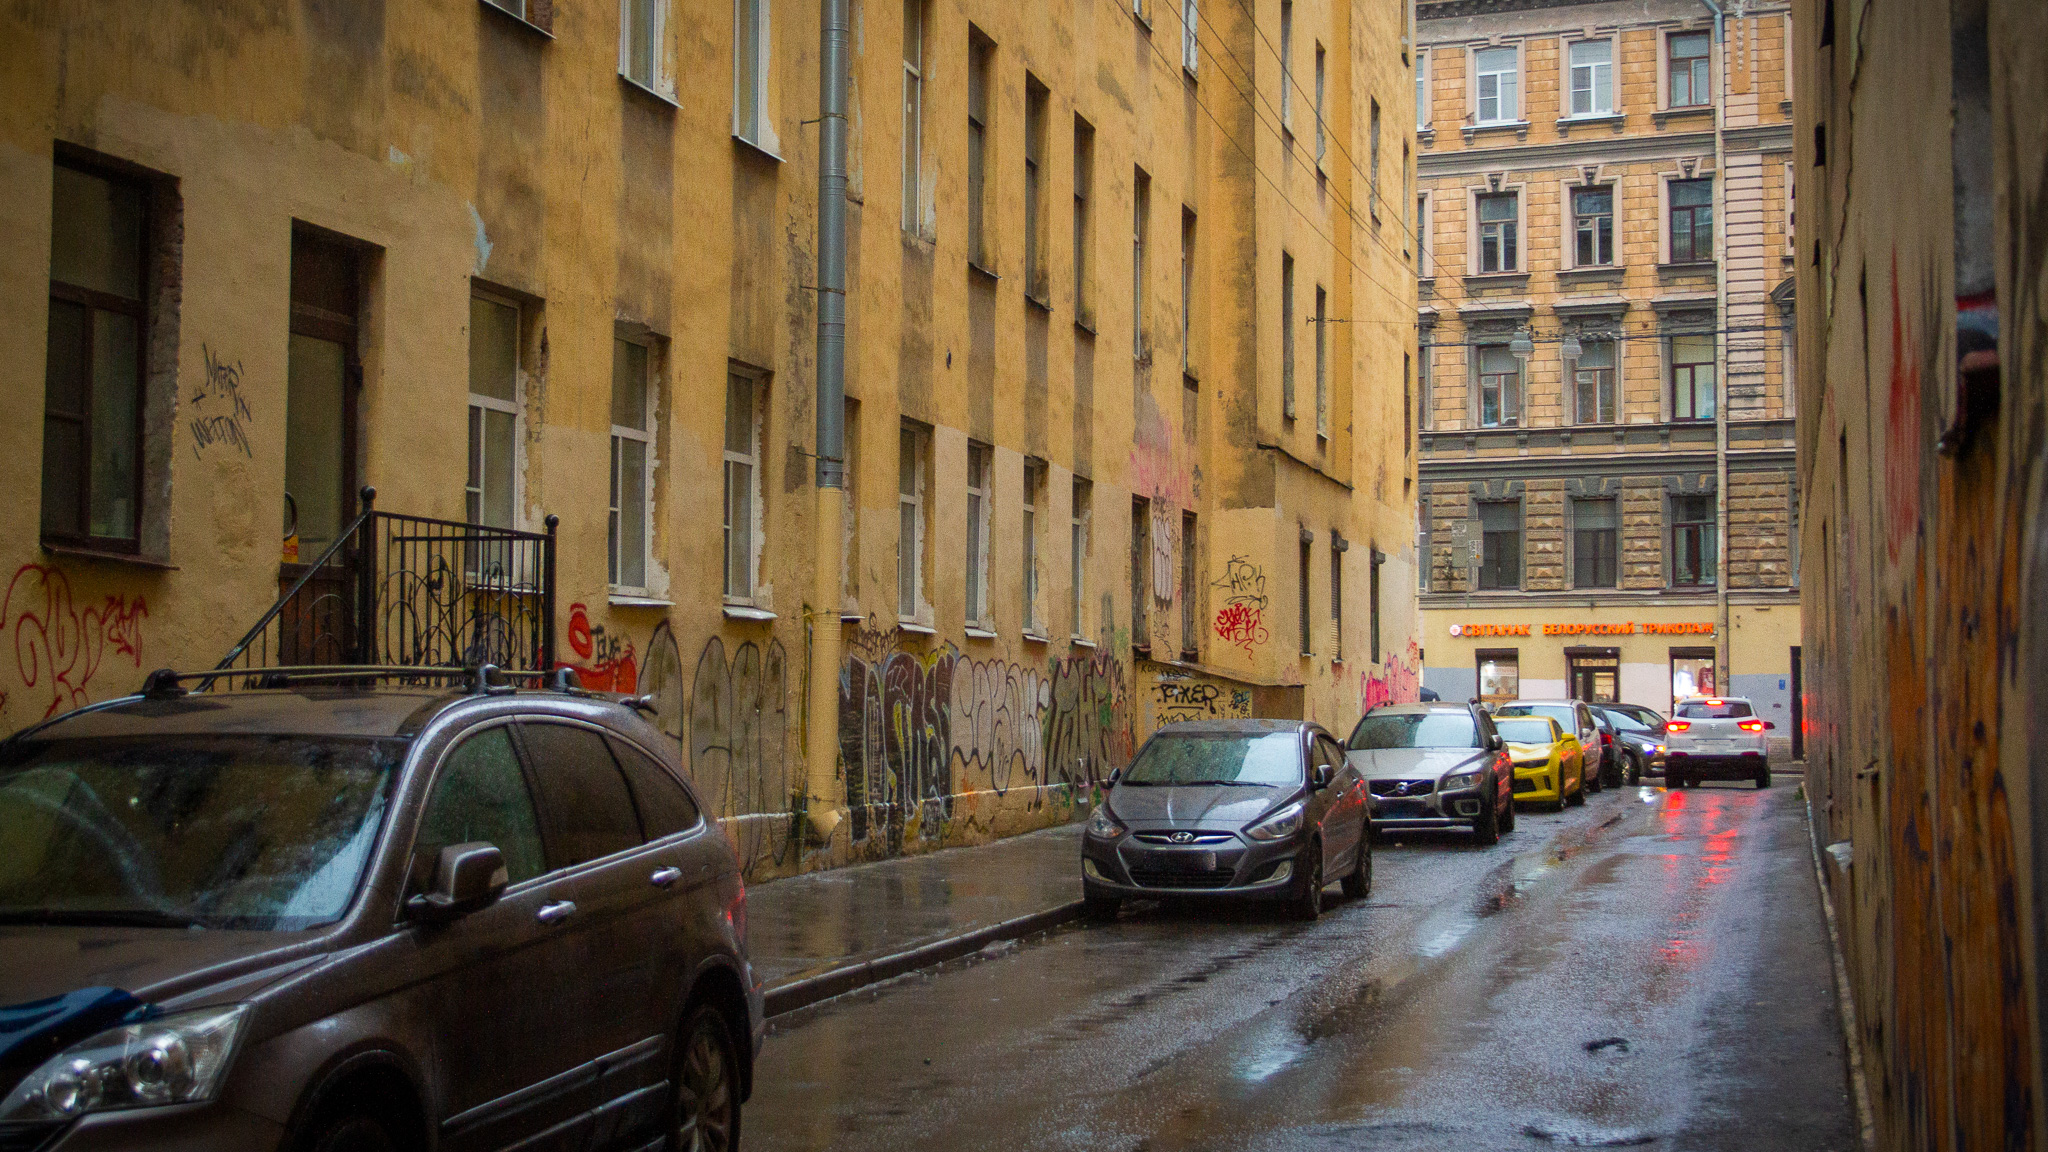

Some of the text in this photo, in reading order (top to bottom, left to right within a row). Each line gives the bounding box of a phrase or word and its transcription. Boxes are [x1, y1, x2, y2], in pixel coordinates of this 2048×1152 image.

[1461, 620, 1714, 637] СВІТАНАК БЕЛОРУССКИЙ ТРИКОТАЖ
